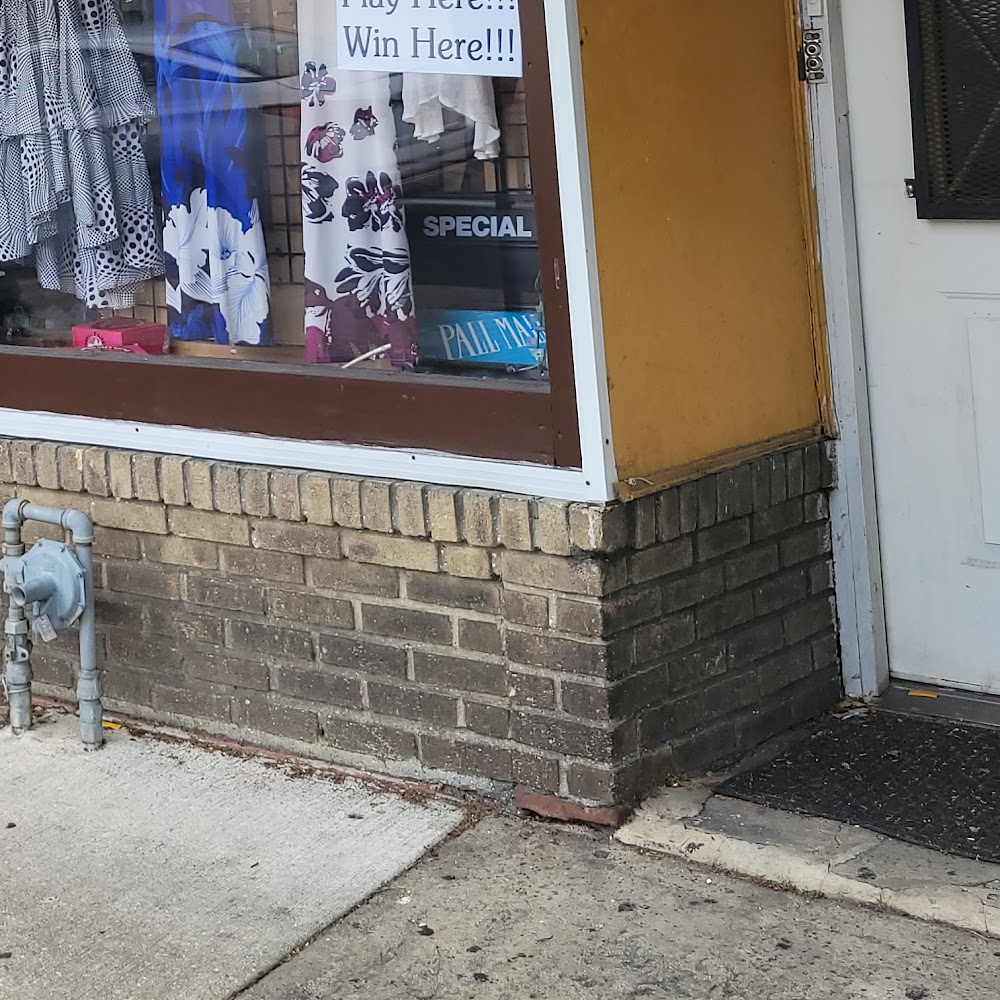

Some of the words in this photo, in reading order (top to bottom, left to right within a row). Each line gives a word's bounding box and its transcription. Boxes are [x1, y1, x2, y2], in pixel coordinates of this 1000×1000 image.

[343, 25, 399, 58] Win
[411, 27, 514, 62] Here!!!
[423, 215, 532, 237] SPECIAL
[439, 320, 501, 361] PALL
[494, 314, 547, 350] MAL
